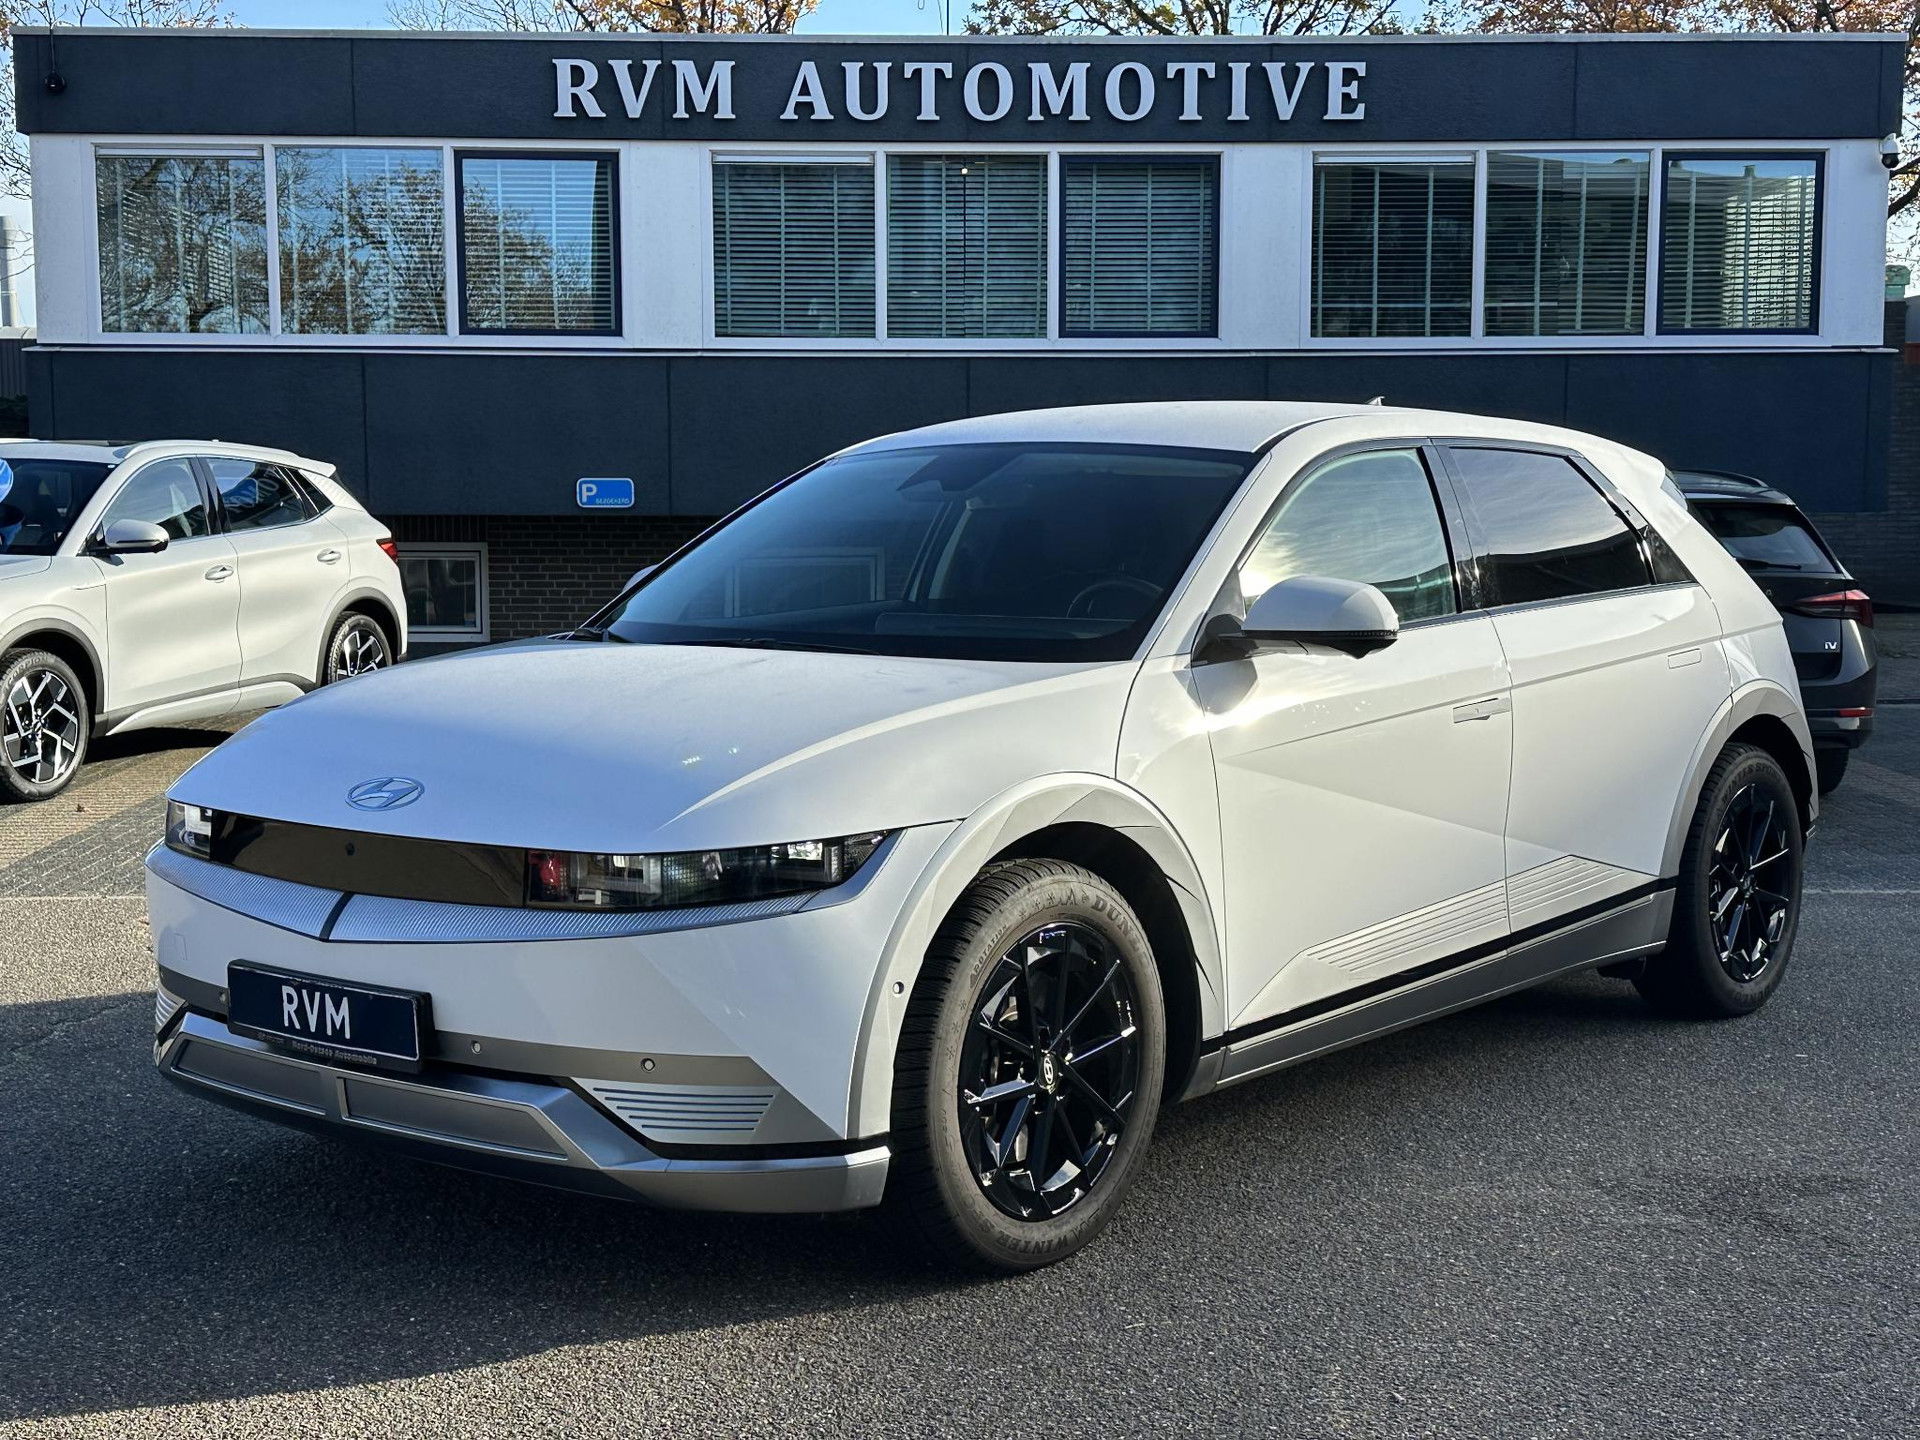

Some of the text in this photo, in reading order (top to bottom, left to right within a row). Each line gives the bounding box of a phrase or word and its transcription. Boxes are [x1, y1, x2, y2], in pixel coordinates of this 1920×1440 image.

[552, 58, 1367, 121] RVM AUTOMOTIVE
[581, 483, 597, 503] P
[281, 985, 350, 1039] RVM
